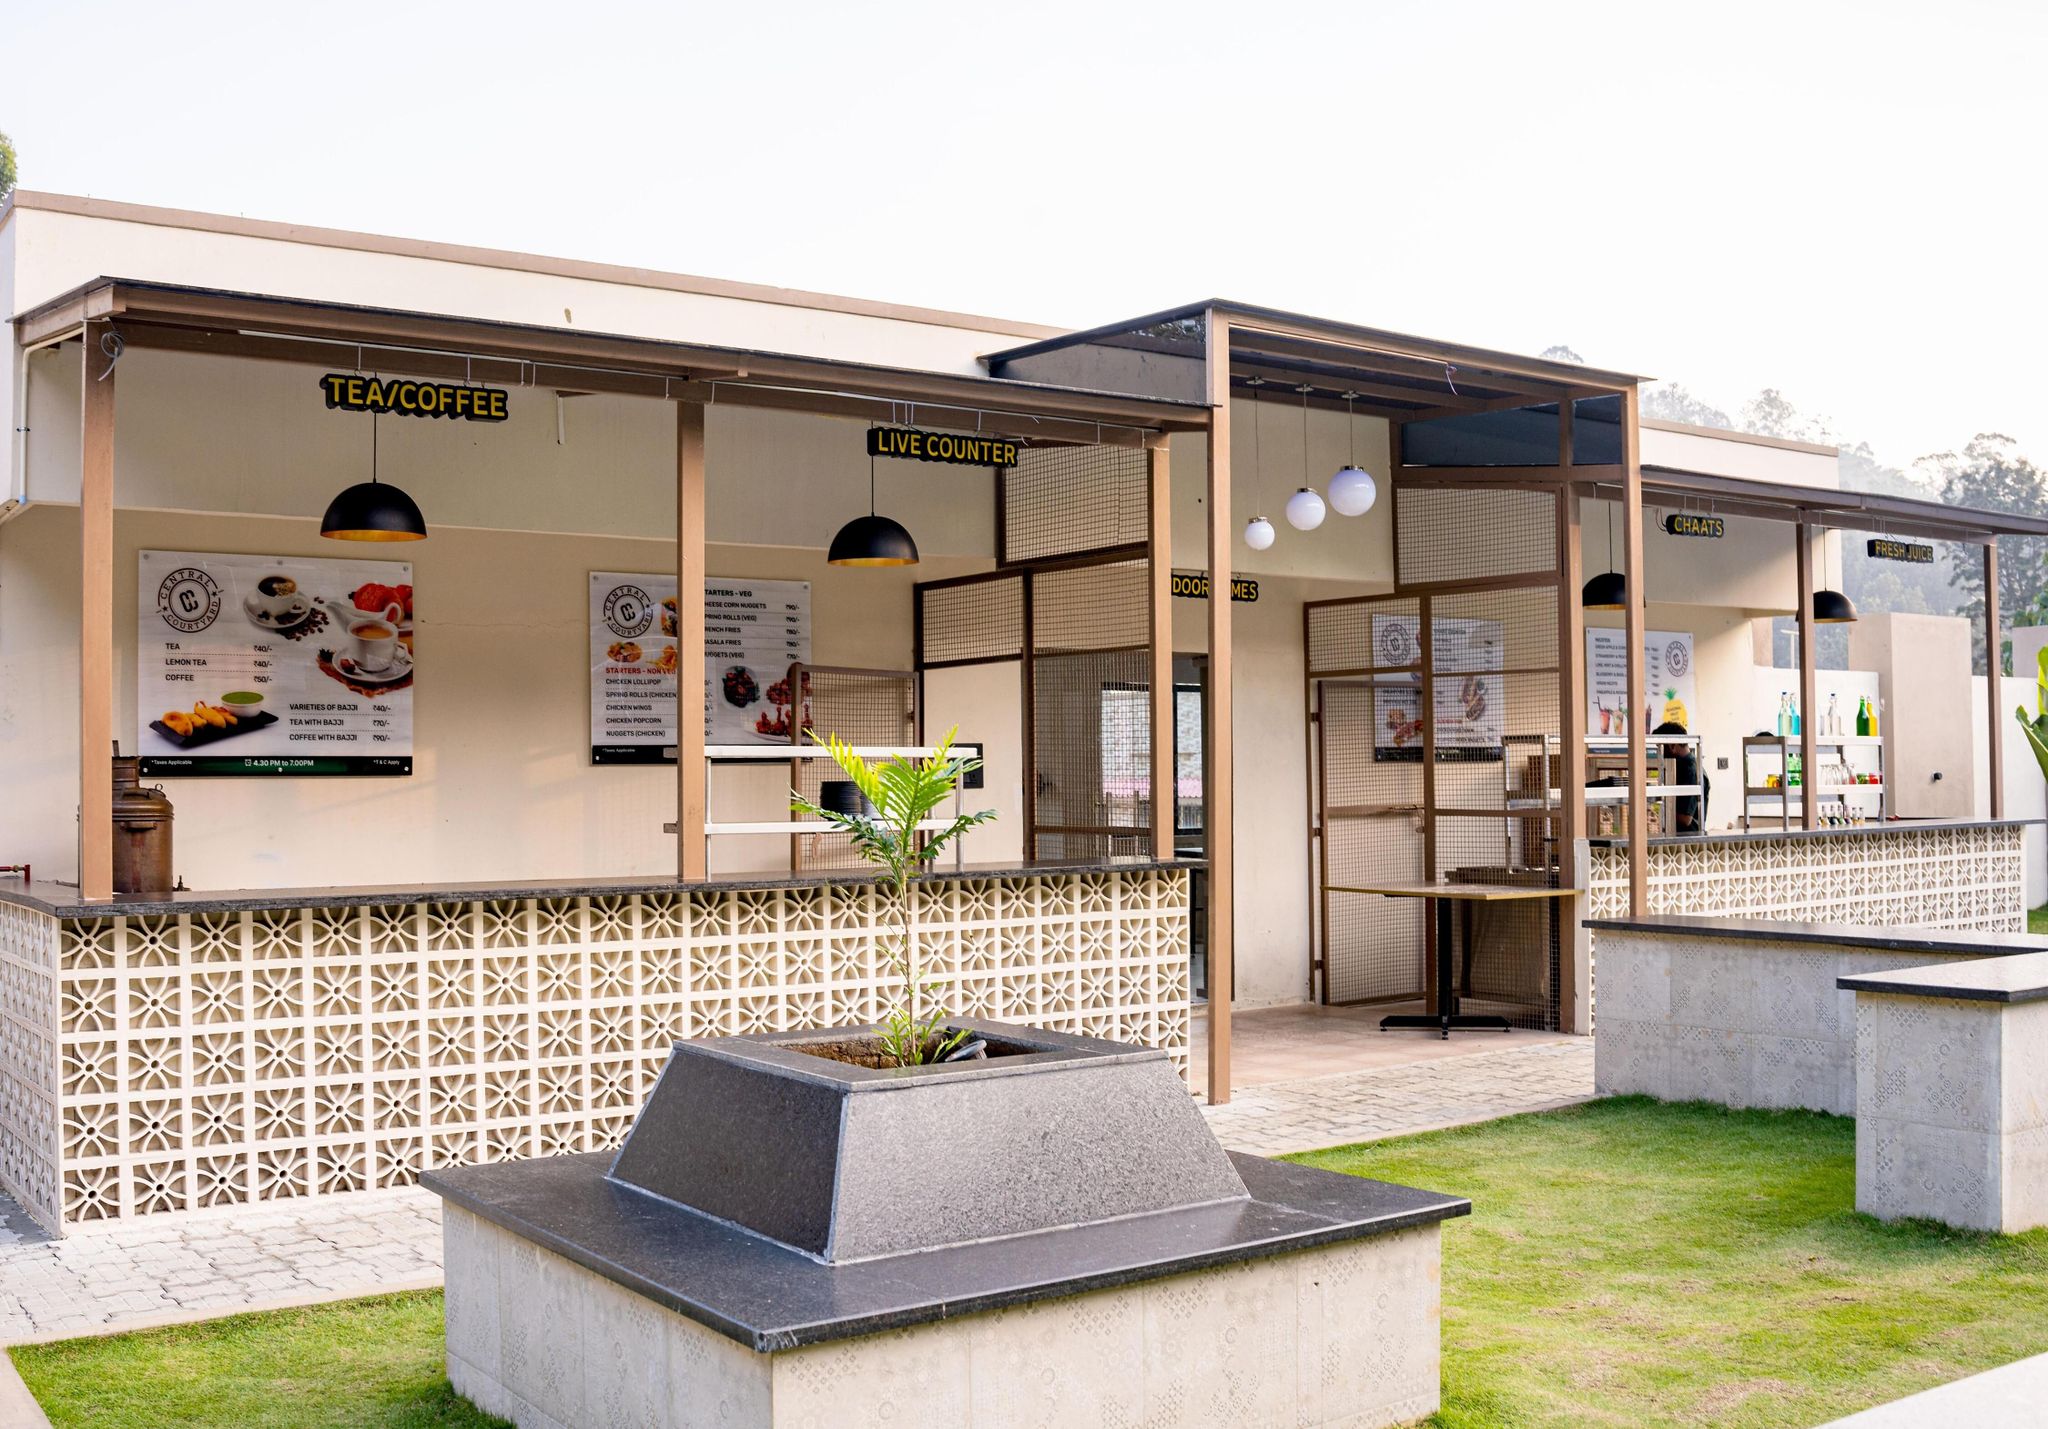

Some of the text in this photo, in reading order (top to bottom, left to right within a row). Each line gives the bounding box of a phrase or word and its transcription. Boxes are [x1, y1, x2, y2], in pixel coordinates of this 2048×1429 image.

[328, 377, 505, 417] TEA/COFFEE
[878, 431, 1016, 464] LIVE COUNTER
[1674, 516, 1723, 536] CHAATS
[1875, 541, 1933, 561] FRESH JUICE
[160, 571, 210, 599] CENTRAL
[1172, 577, 1257, 600] DOOR MES
[605, 587, 644, 611] CENTRAL
[704, 589, 734, 597] TARTERS
[739, 590, 752, 598] VEG
[167, 601, 218, 630] COURTYARD
[741, 614, 757, 622] (VEG)
[610, 612, 651, 636] COURTYARD
[165, 658, 207, 666] LEMON TEA
[728, 651, 744, 659] (VEG)
[633, 678, 661, 686] LOLLIPOP
[649, 691, 677, 699] (CHICKEN
[289, 703, 325, 711] VARIETIES
[289, 718, 344, 726] TEA WITH BAJJI
[289, 759, 314, 767] 7.00PM
